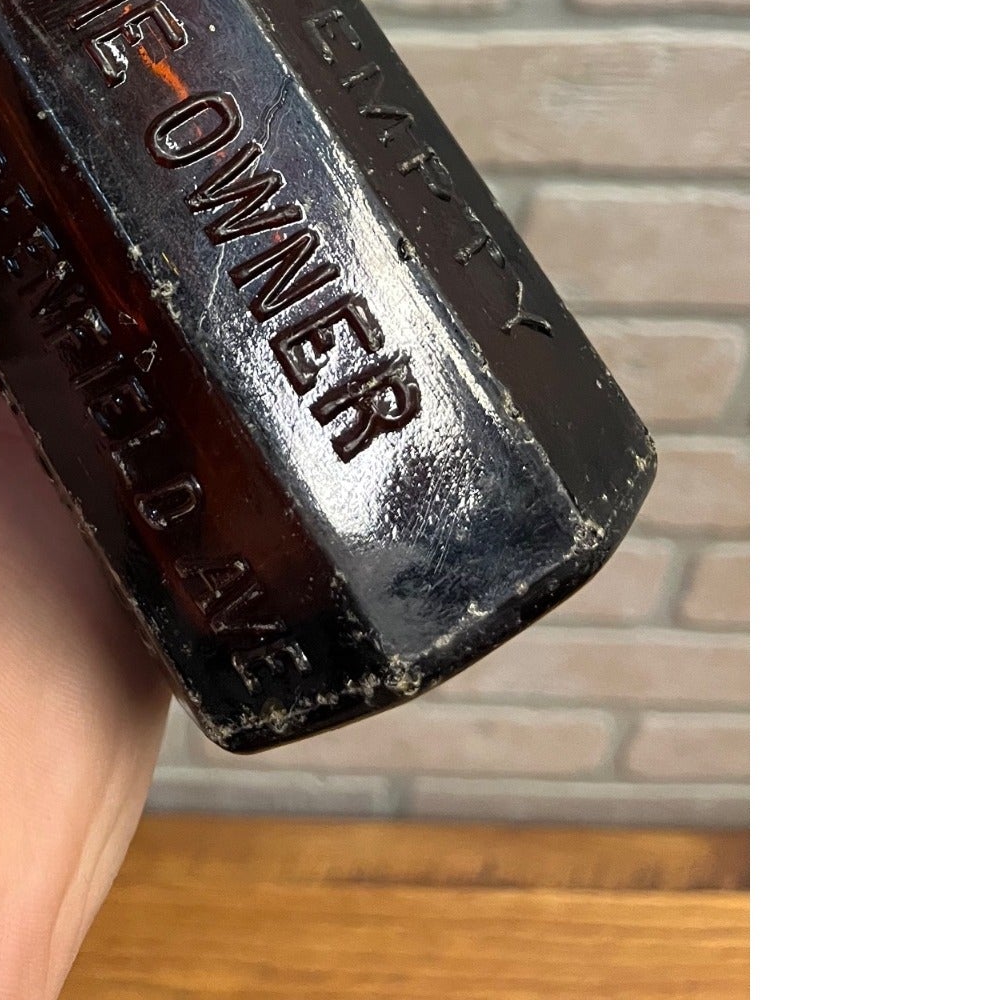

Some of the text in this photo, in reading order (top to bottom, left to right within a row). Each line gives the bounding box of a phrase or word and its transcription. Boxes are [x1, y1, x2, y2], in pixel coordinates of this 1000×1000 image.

[144, 90, 422, 465] OWNER
[303, 6, 555, 340] EMPTY
[173, 557, 309, 695] AVE
